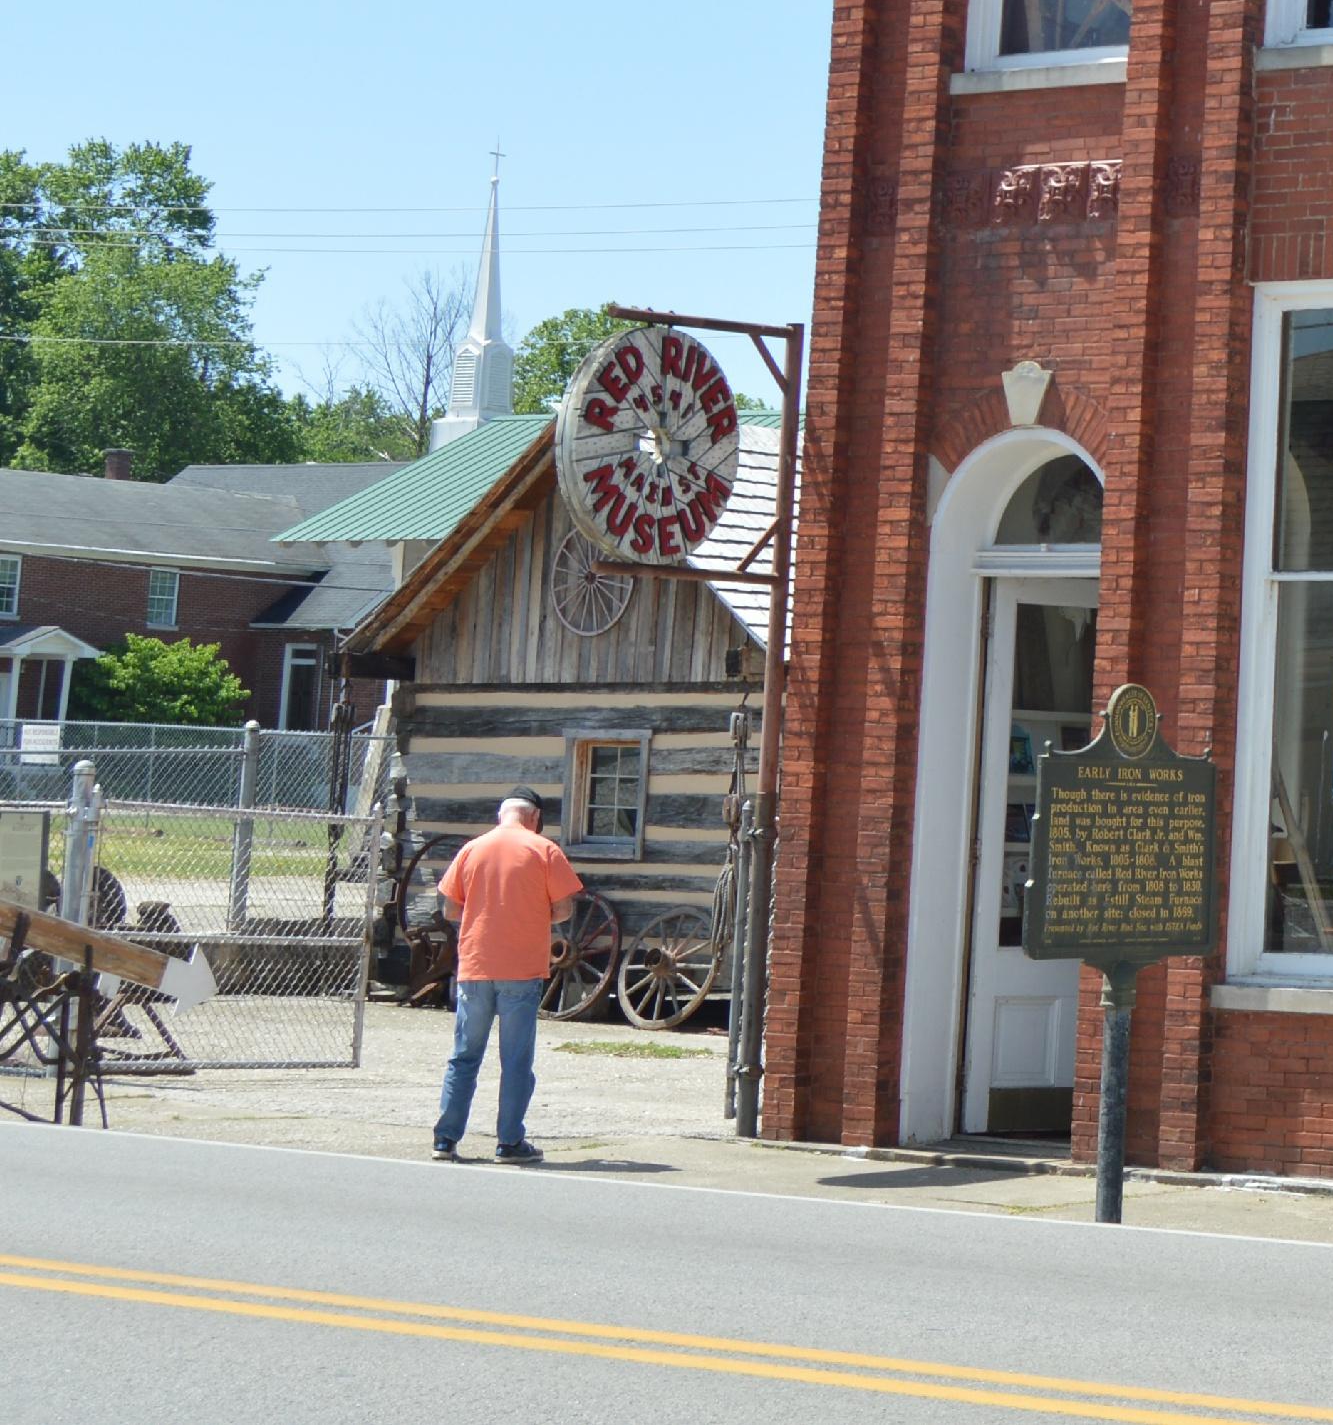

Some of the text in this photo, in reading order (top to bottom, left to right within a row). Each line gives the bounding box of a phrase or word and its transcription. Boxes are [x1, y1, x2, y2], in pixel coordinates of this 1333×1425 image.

[584, 335, 737, 445] RED RIVER
[583, 463, 732, 556] MUSEUM
[1078, 767, 1184, 782] EARLY IRON WORKS
[1052, 787, 1205, 802] Though there is evidence of iron
[1051, 803, 1101, 814] production
[1107, 803, 1117, 813] in
[1123, 805, 1143, 814] area
[1148, 806, 1169, 814] even
[1050, 814, 1069, 825] land
[1076, 817, 1091, 826] was
[1095, 816, 1127, 828] bought
[1130, 817, 1143, 826] for
[1148, 817, 1164, 826] this
[1076, 828, 1088, 841] by
[1092, 829, 1124, 839] Robert
[1127, 829, 1151, 839] Clark
[1155, 829, 1165, 840] Jr.
[1168, 830, 1184, 840] and
[1086, 841, 1116, 852] Known
[1120, 844, 1130, 853] as
[1135, 841, 1159, 853] Clark
[1169, 855, 1176, 865] A
[1182, 856, 1203, 866] blast
[1086, 868, 1112, 879] called
[1115, 868, 1132, 879] Red
[1135, 868, 1157, 879] River
[1159, 868, 1176, 879] Iron
[1179, 869, 1203, 880] Works
[1118, 881, 1140, 892] from
[1169, 882, 1178, 892] to
[1046, 894, 1080, 904] Rebuilt
[1136, 894, 1162, 904] Steam
[1169, 894, 1202, 904] Furnace
[1046, 909, 1057, 918] on
[1062, 908, 1098, 918] another
[1129, 907, 1156, 918] closed
[1160, 908, 1168, 917] in
